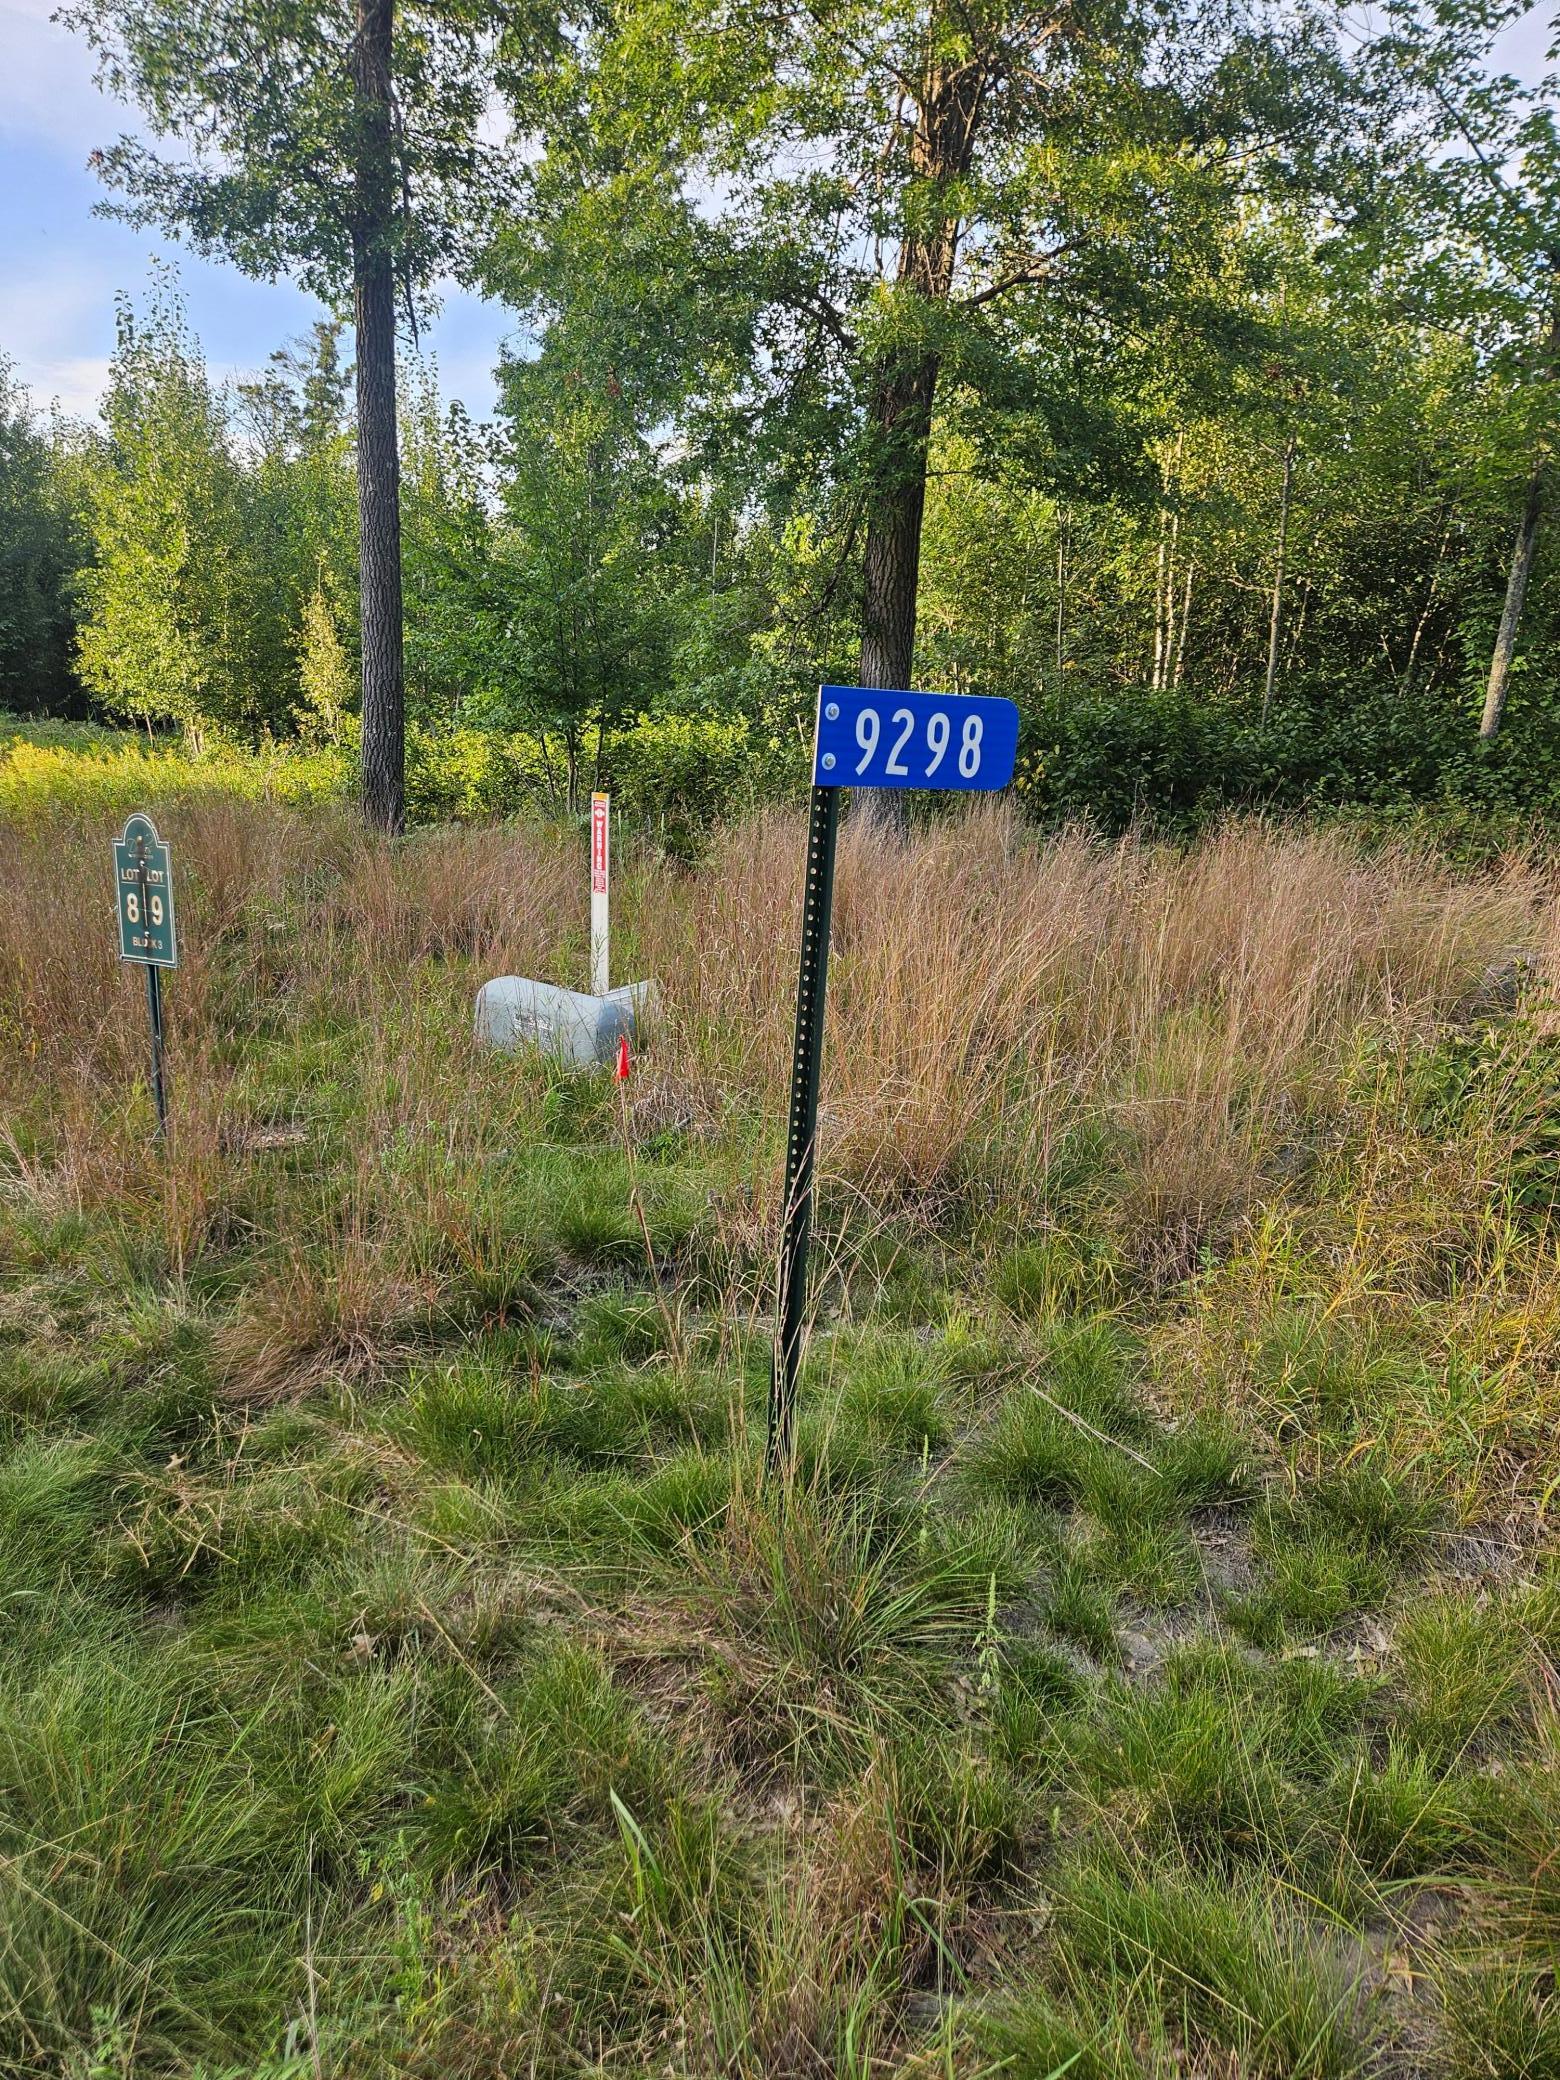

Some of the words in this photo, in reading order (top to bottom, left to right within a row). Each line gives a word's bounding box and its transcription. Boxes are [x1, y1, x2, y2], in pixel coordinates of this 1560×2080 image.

[855, 708, 984, 779] 9298
[596, 820, 604, 869] WARNING
[121, 868, 140, 880] LOT
[146, 870, 164, 883] LOT
[126, 892, 139, 923] 8
[151, 895, 163, 926] 9
[132, 936, 157, 949] BLOK
